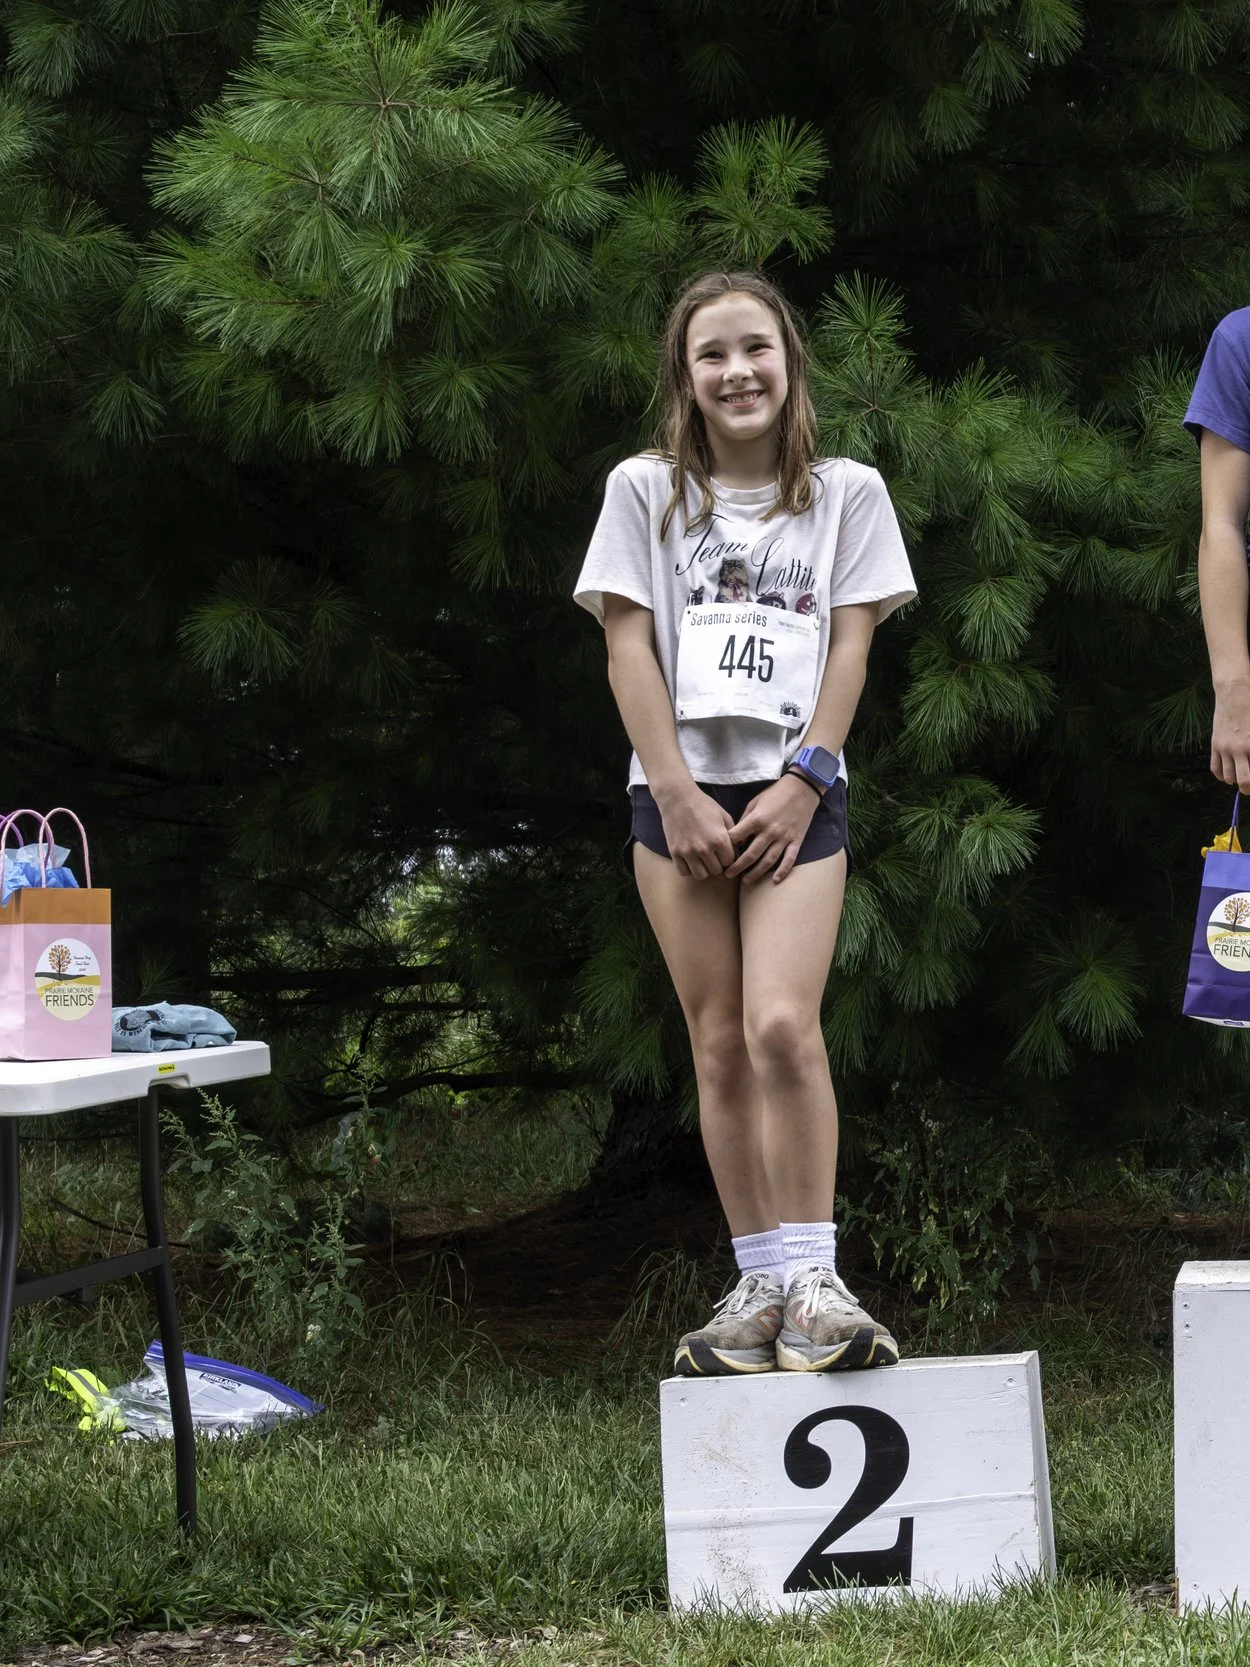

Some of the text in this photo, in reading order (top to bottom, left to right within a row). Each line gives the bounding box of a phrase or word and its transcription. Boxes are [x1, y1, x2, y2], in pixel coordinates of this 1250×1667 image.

[675, 512, 748, 576] Team
[691, 612, 732, 626] Savanna
[735, 611, 768, 627] series
[718, 634, 775, 683] 445
[1214, 936, 1239, 945] PRAIRIE
[67, 986, 94, 994] MORAINE
[45, 994, 94, 1007] FRIENDS
[203, 1372, 239, 1388] KIRKLAND
[783, 1405, 914, 1594] 2
